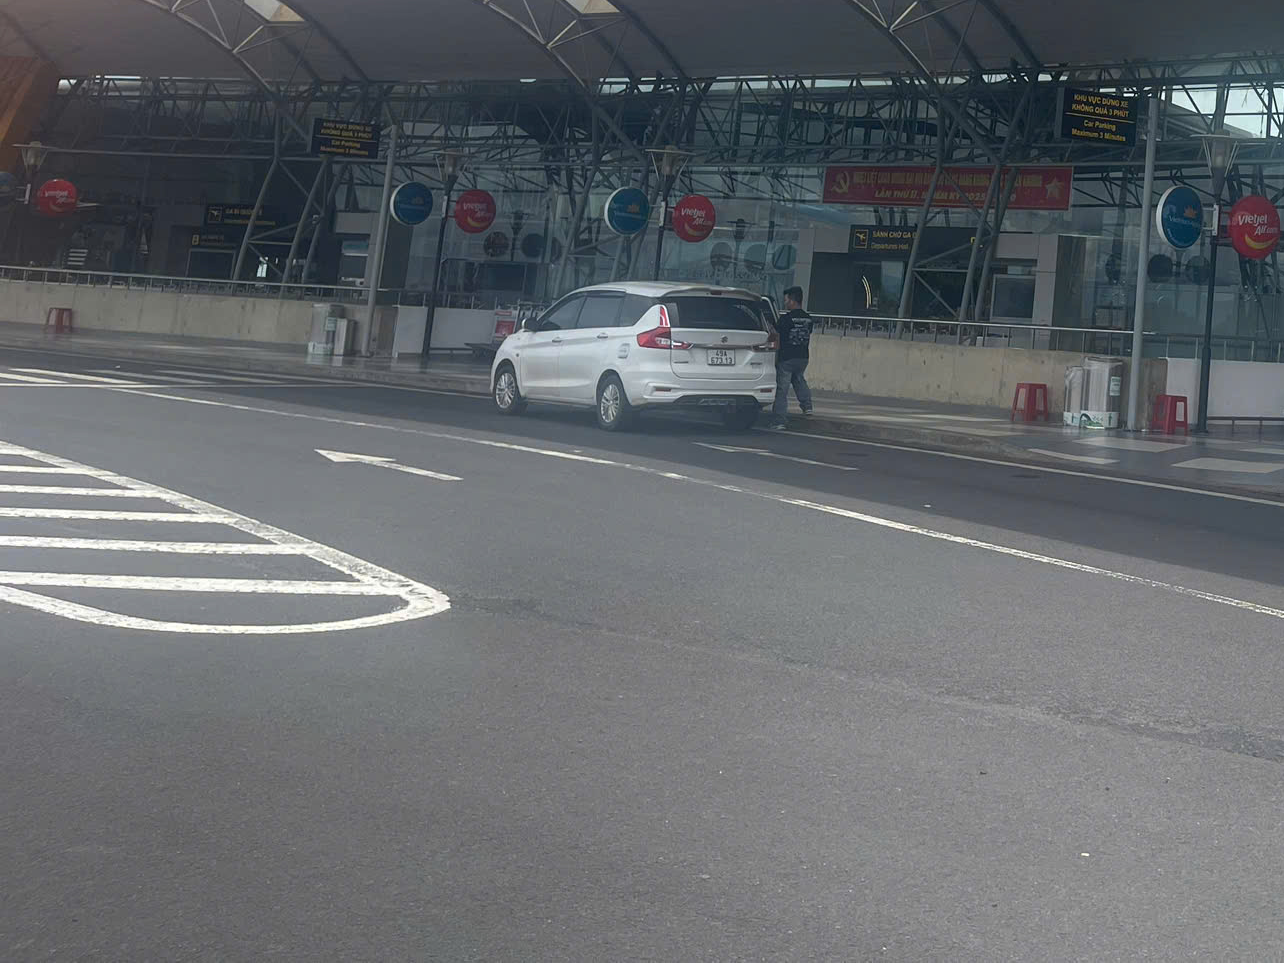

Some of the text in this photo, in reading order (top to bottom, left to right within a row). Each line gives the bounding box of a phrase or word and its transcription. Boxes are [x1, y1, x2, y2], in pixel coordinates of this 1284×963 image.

[1074, 94, 1087, 102] KHU
[1072, 103, 1094, 112] KHÔNG
[1083, 119, 1116, 132] Car Parking
